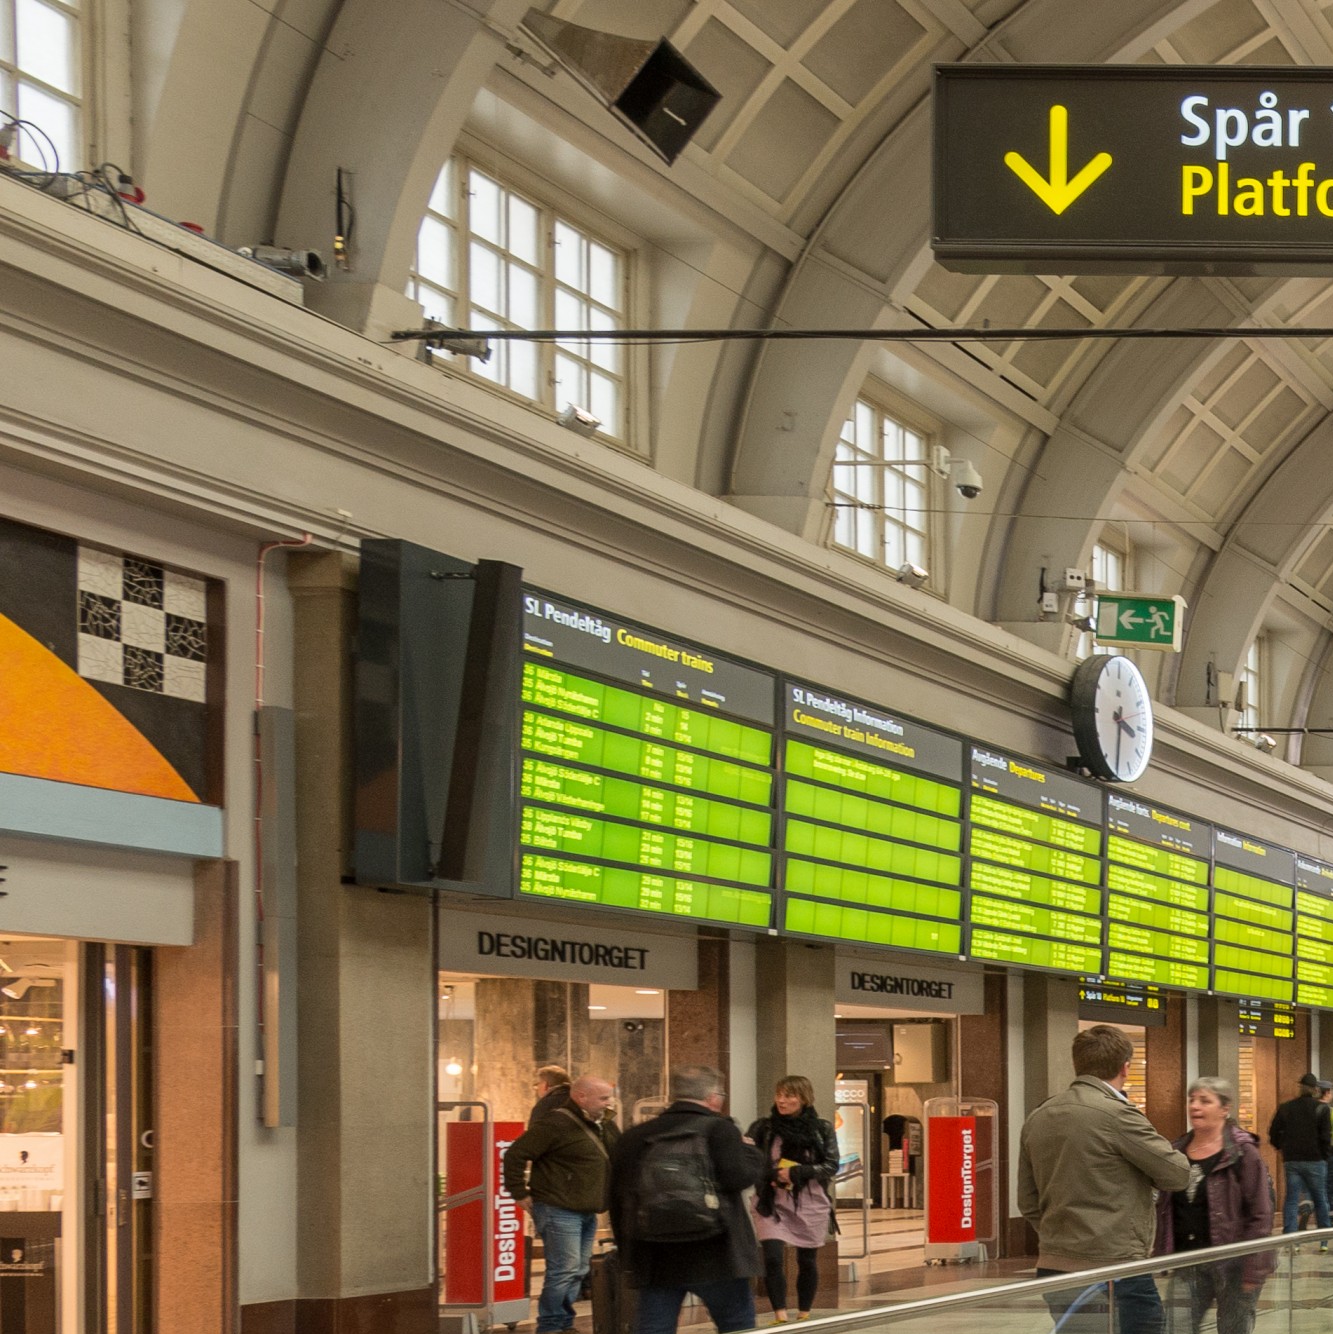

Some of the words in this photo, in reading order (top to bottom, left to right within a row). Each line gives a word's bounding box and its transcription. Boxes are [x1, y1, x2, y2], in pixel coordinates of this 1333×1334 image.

[1181, 92, 1310, 160] Spår
[524, 597, 543, 617] SL
[545, 603, 612, 643] Pendeltåg
[616, 628, 679, 663] Commuter
[682, 652, 714, 674] trains
[793, 688, 806, 703] SL
[807, 692, 853, 722] Pendeltåg
[793, 709, 842, 736] Commuter
[843, 723, 865, 744] train
[477, 931, 650, 970] DESIGNTORGET
[850, 970, 955, 1000] DESIGNTORGET
[834, 1089, 865, 1098] ecco
[961, 1129, 973, 1229] DesignTorget
[494, 1139, 519, 1282] DesignTot
